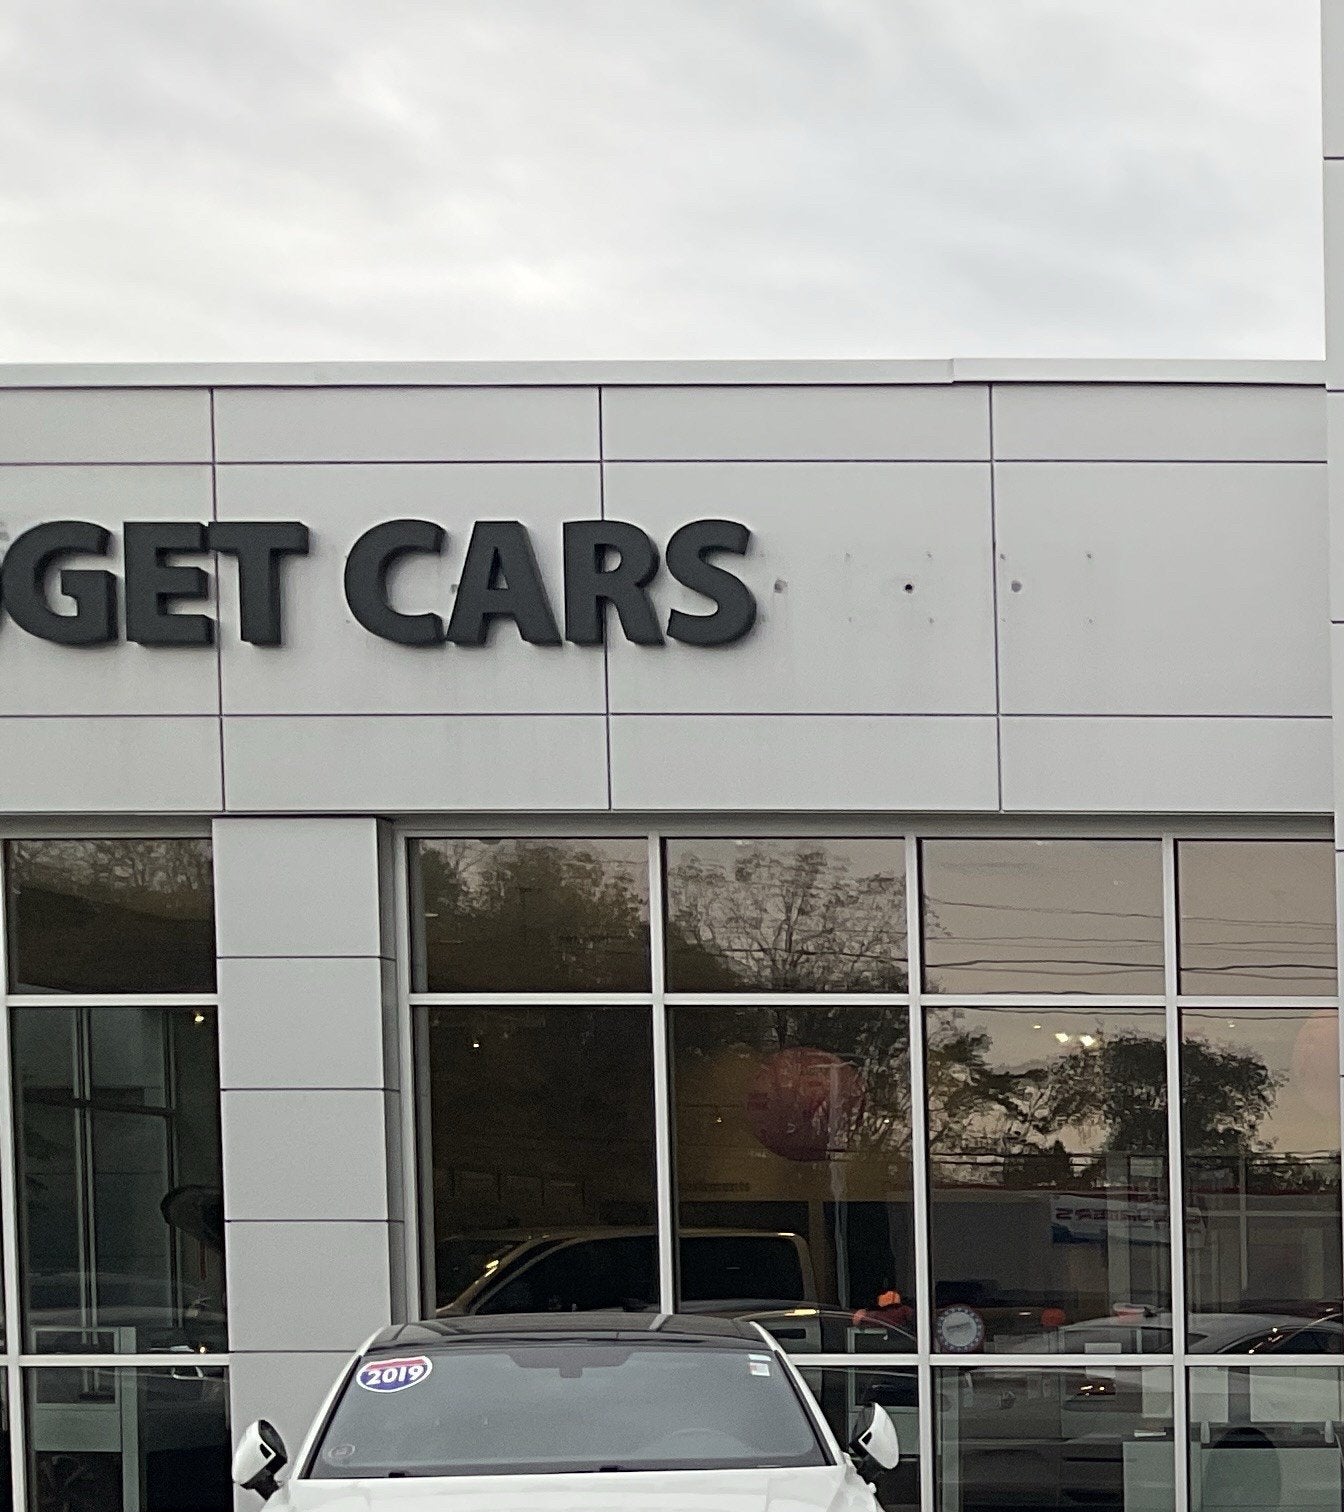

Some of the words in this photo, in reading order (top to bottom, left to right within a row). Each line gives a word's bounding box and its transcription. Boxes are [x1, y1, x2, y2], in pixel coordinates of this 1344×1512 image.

[0, 519, 310, 650] GET
[343, 518, 758, 650] CARS
[365, 1364, 425, 1386] 2019
